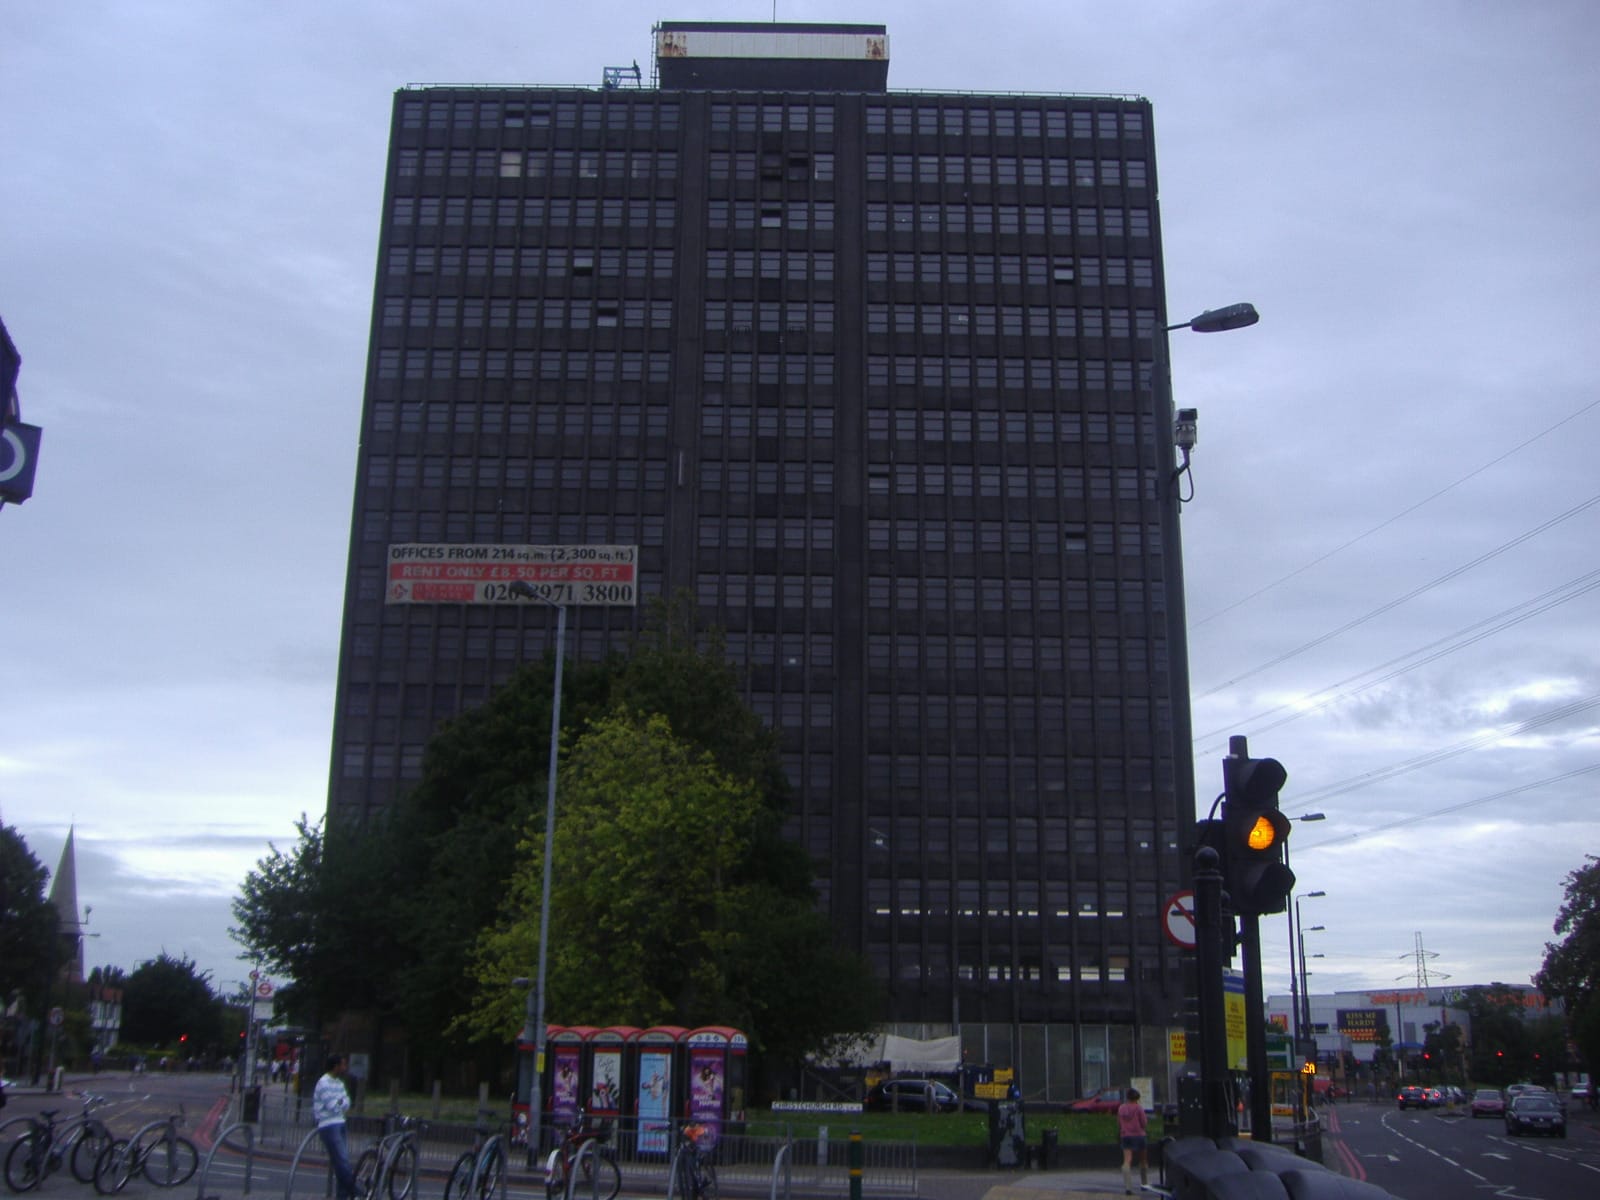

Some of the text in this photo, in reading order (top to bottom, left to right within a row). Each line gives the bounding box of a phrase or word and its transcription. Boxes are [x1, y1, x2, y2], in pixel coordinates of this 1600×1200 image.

[391, 547, 444, 560] OFFICES
[447, 547, 489, 560] FROM
[492, 548, 515, 560] 214
[550, 547, 597, 562] (2,300
[403, 566, 441, 577] RENT
[446, 566, 484, 577] ONLY
[540, 567, 569, 578] PER
[530, 584, 574, 602] 971
[583, 584, 633, 602] 3800
